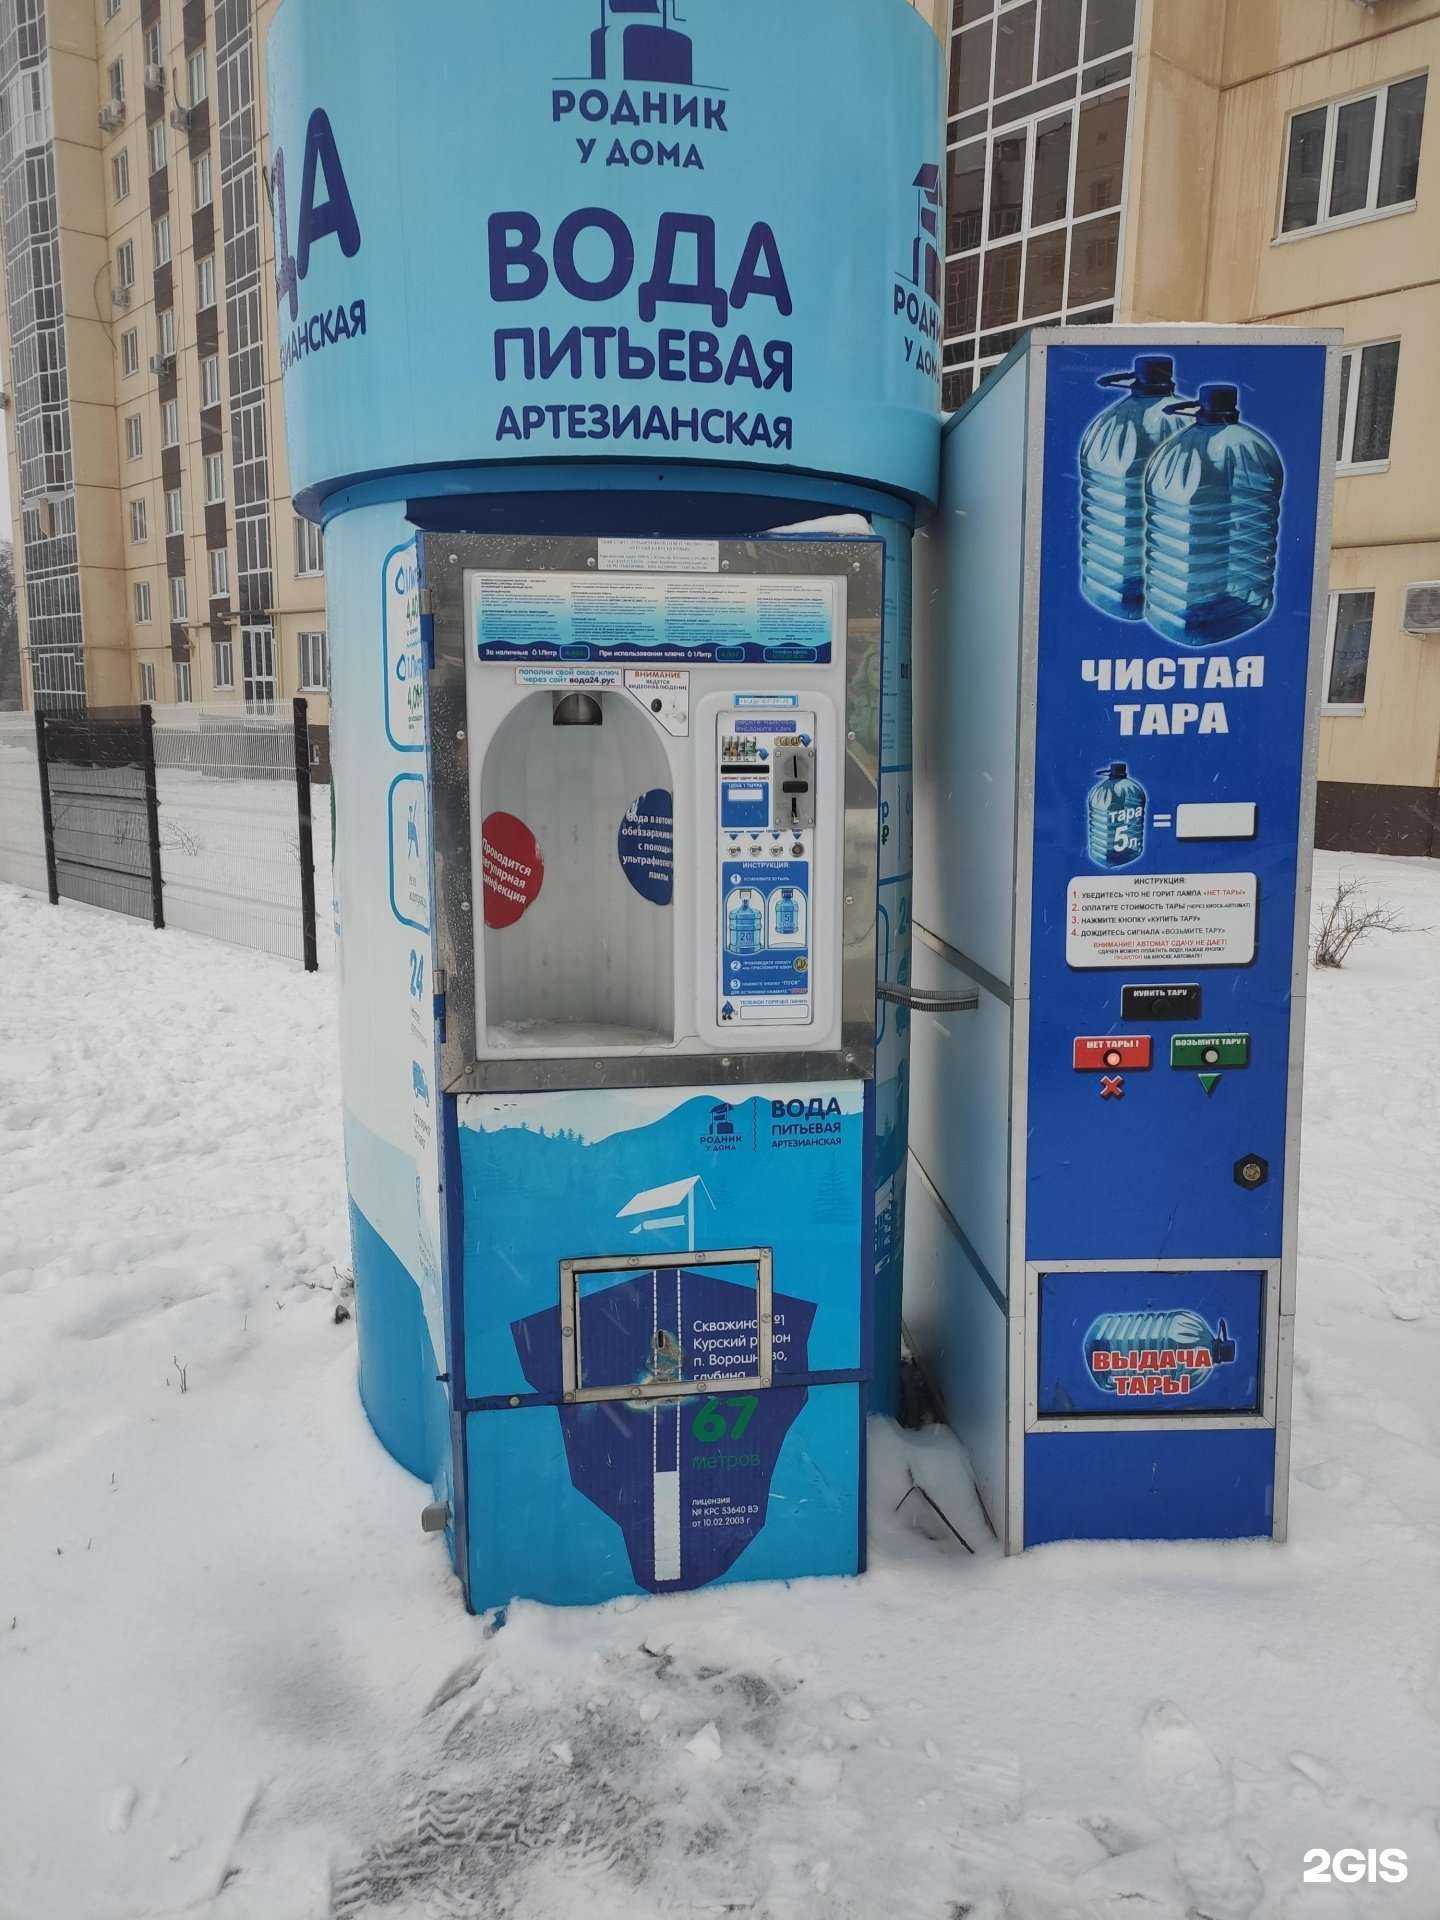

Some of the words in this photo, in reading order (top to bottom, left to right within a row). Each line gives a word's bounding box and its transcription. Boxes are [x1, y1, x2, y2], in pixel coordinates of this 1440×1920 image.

[552, 88, 729, 133] РОДНИК
[576, 138, 597, 165] У
[605, 138, 705, 170] ДОМА
[487, 206, 793, 329] ВОДА
[904, 335, 914, 363] У
[493, 325, 793, 393] ПИТЬЕВАЯ
[495, 404, 793, 451] АРТЕЗИАНСКАЯ
[555, 668, 575, 676] свой
[634, 671, 681, 679] ВНИМАНИЕ
[1081, 655, 1265, 691] ЧИСТАЯ
[523, 676, 547, 684] через
[569, 675, 615, 685] вода24.рус
[1113, 702, 1229, 736] ТАРА
[1109, 806, 1143, 823] тара
[484, 857, 526, 889] егулярная
[1134, 877, 1185, 886] ИНСТРУКЦИЯ
[1082, 891, 1124, 899] УБЕДИТЕСЬ
[1141, 890, 1151, 898] НЕ
[1177, 889, 1202, 897] ЛАМПА
[1072, 903, 1080, 912] 2.
[1120, 903, 1164, 911] СТОИМОСТЬ
[1072, 915, 1080, 925] 3.
[1071, 928, 1080, 937] 4.
[1081, 929, 1125, 937] ДОЖДИТЕСЬ
[1136, 940, 1169, 948] АВТОМАТ
[1170, 939, 1194, 947] СДАЧУ
[1133, 989, 1165, 997] КУПИТЬ
[1167, 989, 1188, 997] ТАРУ
[1086, 1040, 1103, 1049] НЕТ
[1175, 1039, 1220, 1047] ВОЗЬМИТЕ
[771, 1097, 842, 1121] ВОДА
[771, 1122, 842, 1137] ПИТЬЕВАЯ
[700, 1135, 742, 1144] РОДНИК
[771, 1137, 842, 1149] АРТЕЗИАНСКАЯ
[693, 1318, 758, 1333] Скважина
[693, 1332, 747, 1352] Курский
[694, 1356, 705, 1367] п.
[1092, 1348, 1214, 1373] ВЫДАЧА
[1113, 1374, 1191, 1396] ТАРЫ
[692, 1395, 759, 1443] 67
[692, 1453, 760, 1472] метров
[692, 1497, 731, 1506] лицензия
[704, 1507, 720, 1515] КРС
[721, 1505, 746, 1514] 53640
[747, 1504, 759, 1513] ВЭ
[691, 1520, 701, 1528] от
[703, 1516, 745, 1527] 10.02.2003
